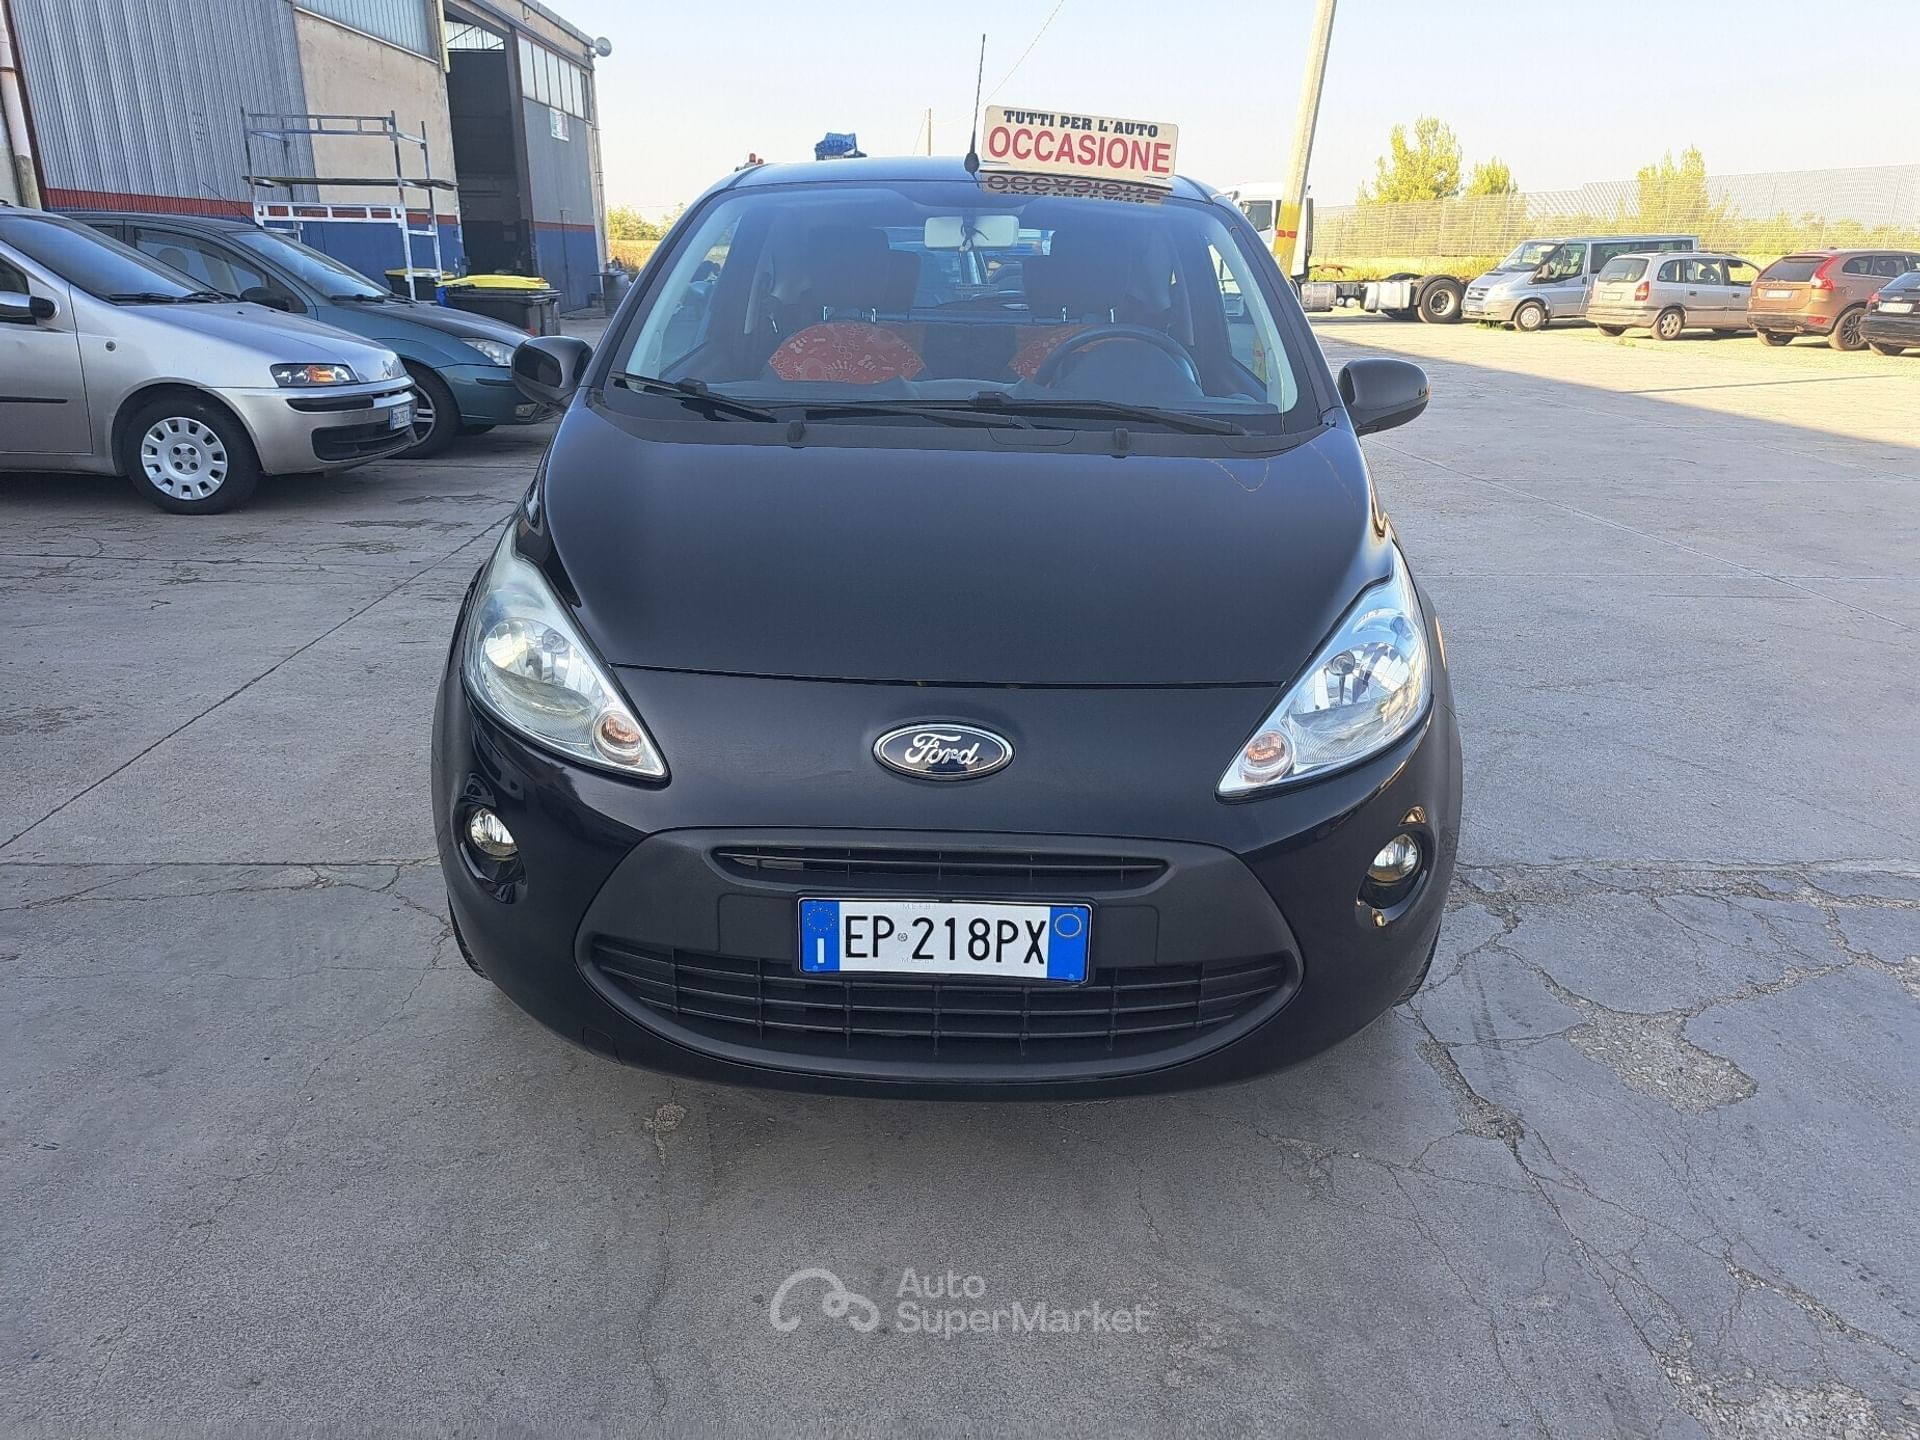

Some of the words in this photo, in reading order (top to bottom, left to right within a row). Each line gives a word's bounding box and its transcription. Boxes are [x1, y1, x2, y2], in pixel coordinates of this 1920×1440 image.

[1003, 110, 1055, 127] TUTTI
[1059, 115, 1093, 131] PER
[1097, 119, 1158, 138] L'AUTO
[988, 126, 1171, 173] OCCASIONE
[905, 733, 978, 765] Ford
[845, 915, 895, 958] EP
[911, 917, 1047, 964] 218PX
